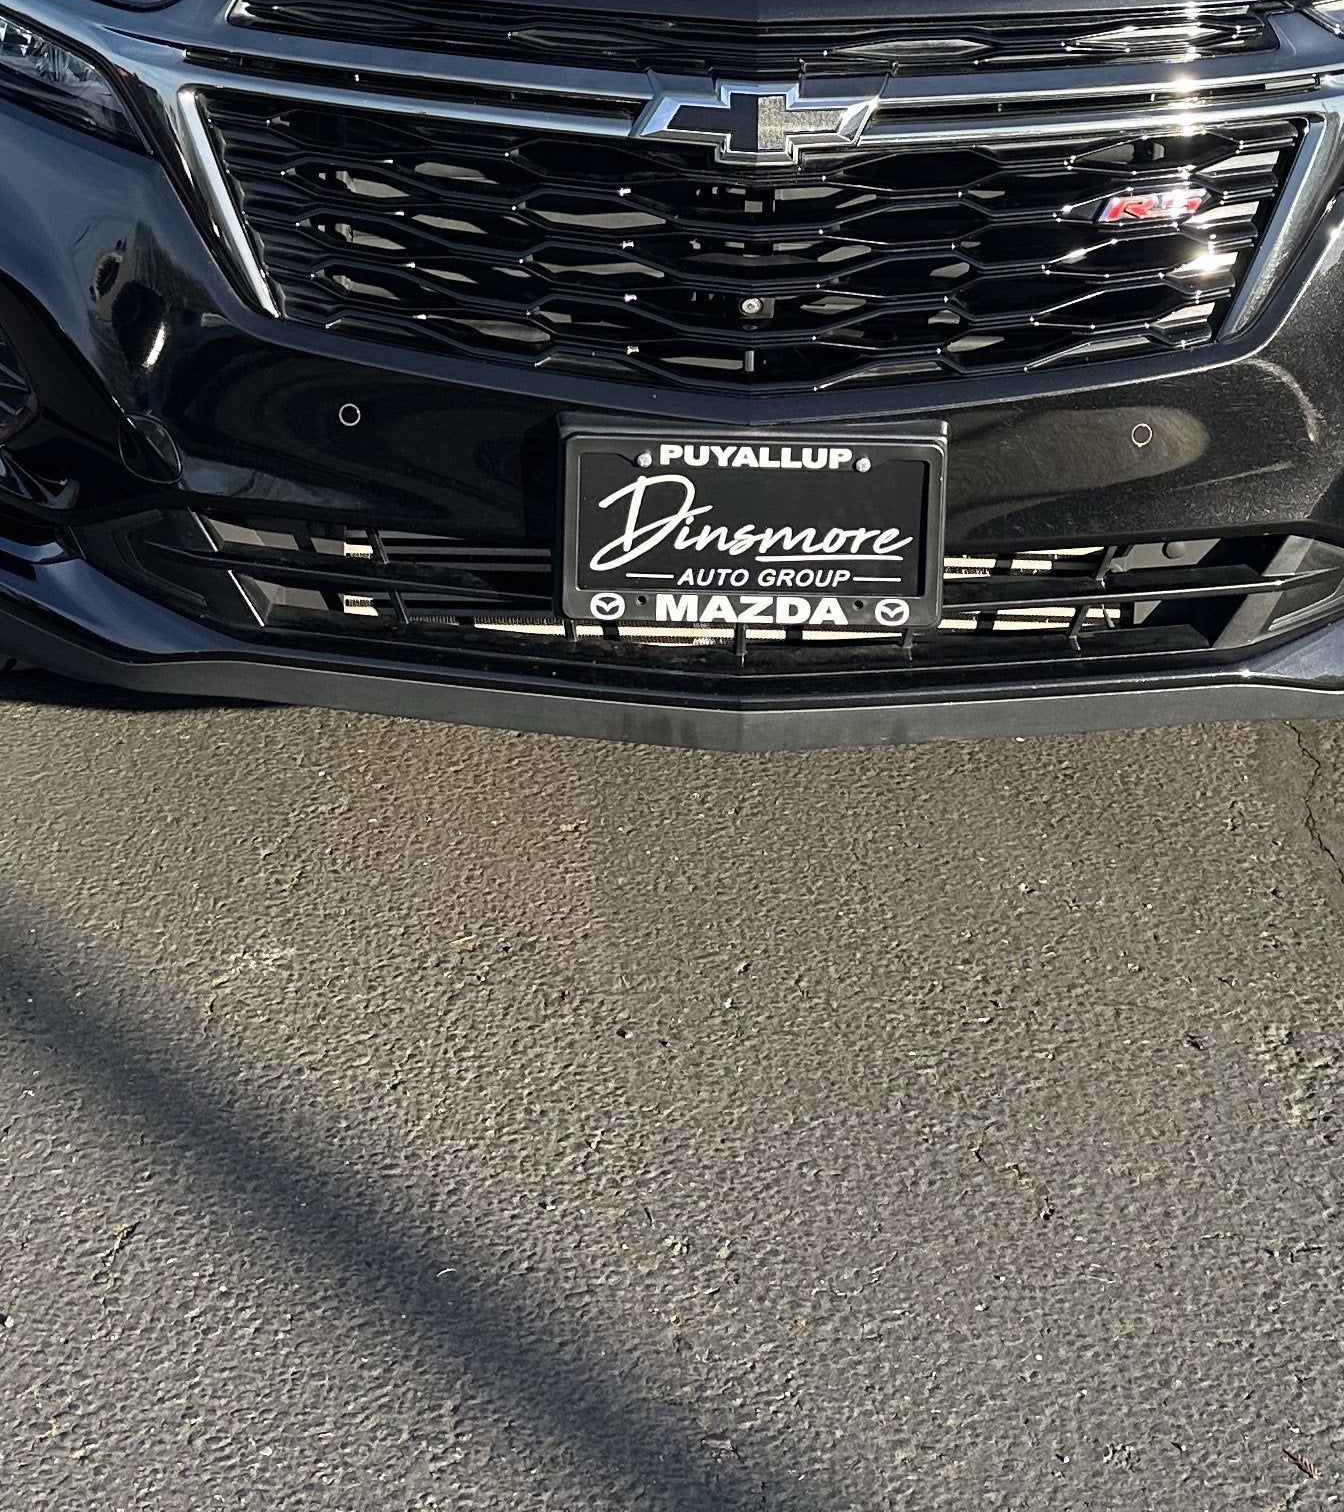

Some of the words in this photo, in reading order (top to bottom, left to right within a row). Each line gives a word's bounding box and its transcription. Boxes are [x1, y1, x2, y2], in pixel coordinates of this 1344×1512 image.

[659, 444, 853, 470] PUYALLUP
[590, 474, 914, 572] Dinsmore
[677, 568, 750, 588] AUTO
[757, 569, 852, 589] GROUP
[656, 594, 849, 626] MAZDA
